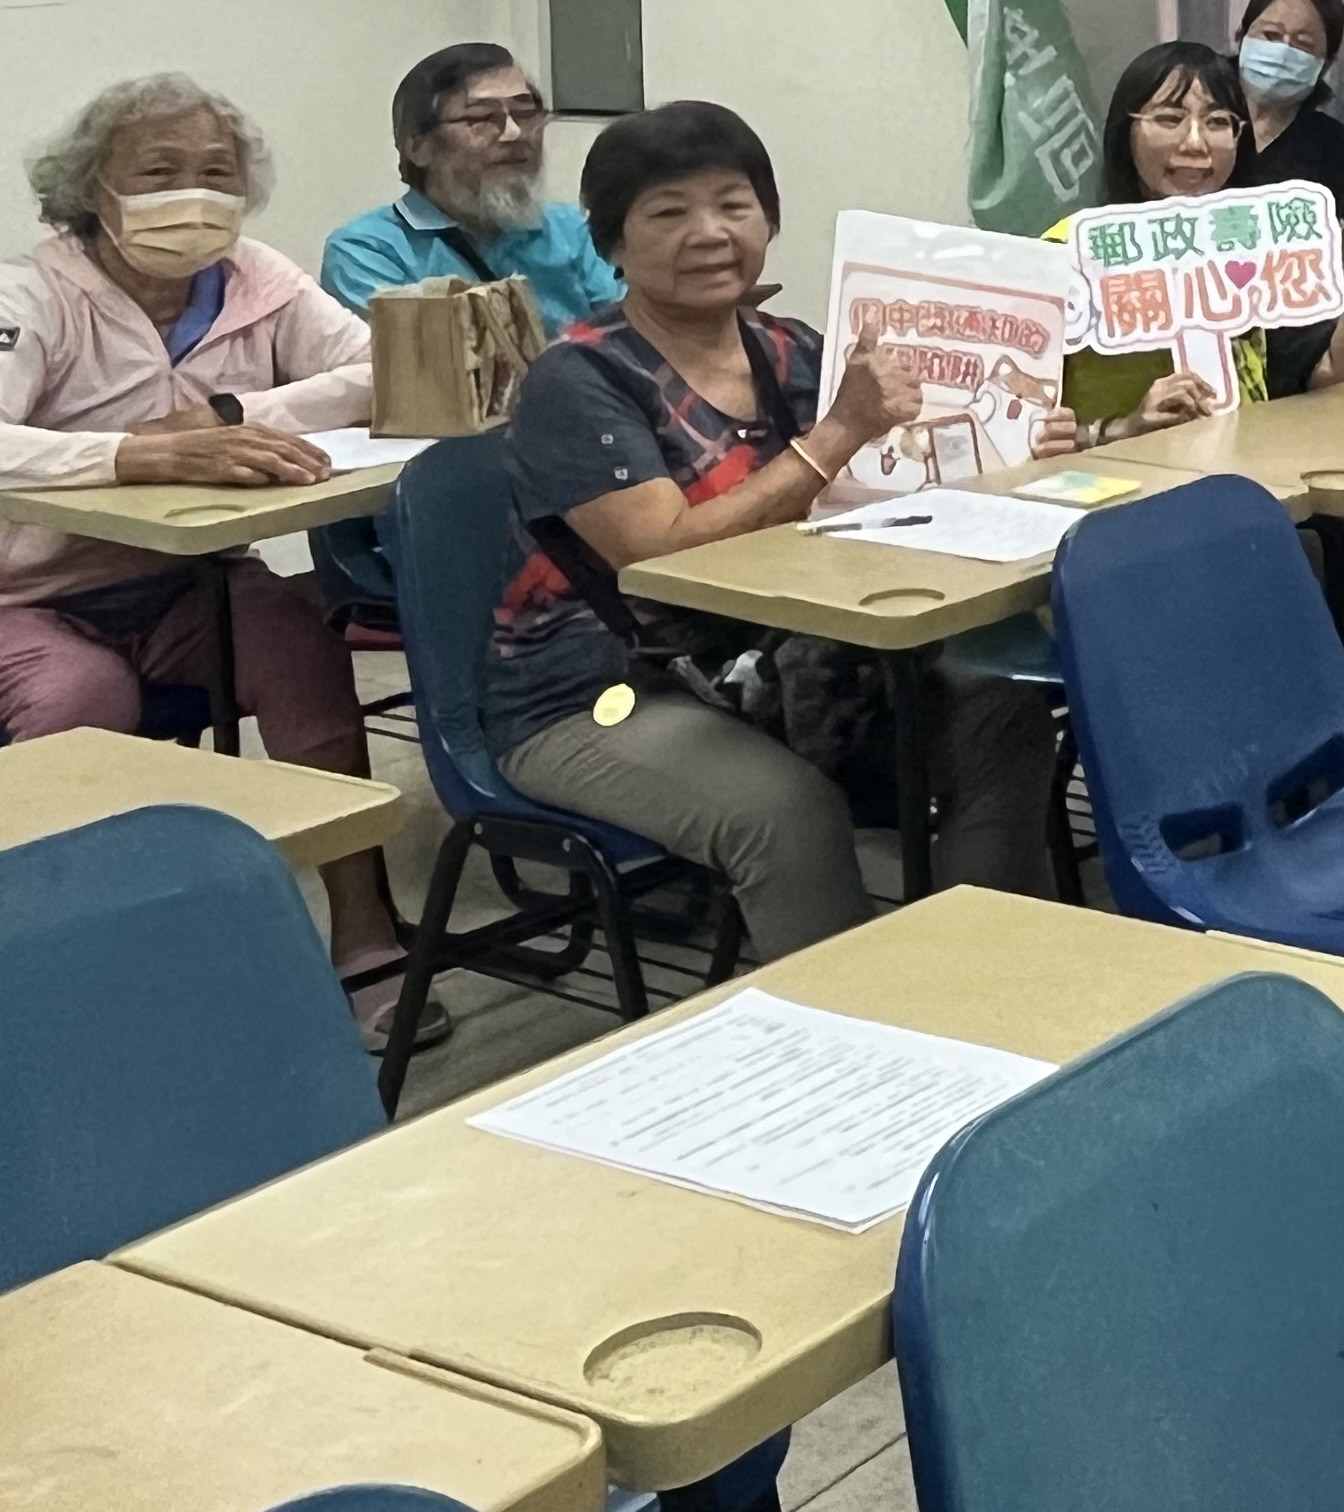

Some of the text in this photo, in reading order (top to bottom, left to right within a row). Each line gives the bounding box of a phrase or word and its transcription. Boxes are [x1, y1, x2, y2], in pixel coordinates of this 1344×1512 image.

[1087, 196, 1323, 267] 郵政壽險
[1099, 249, 1329, 337] 關心您
